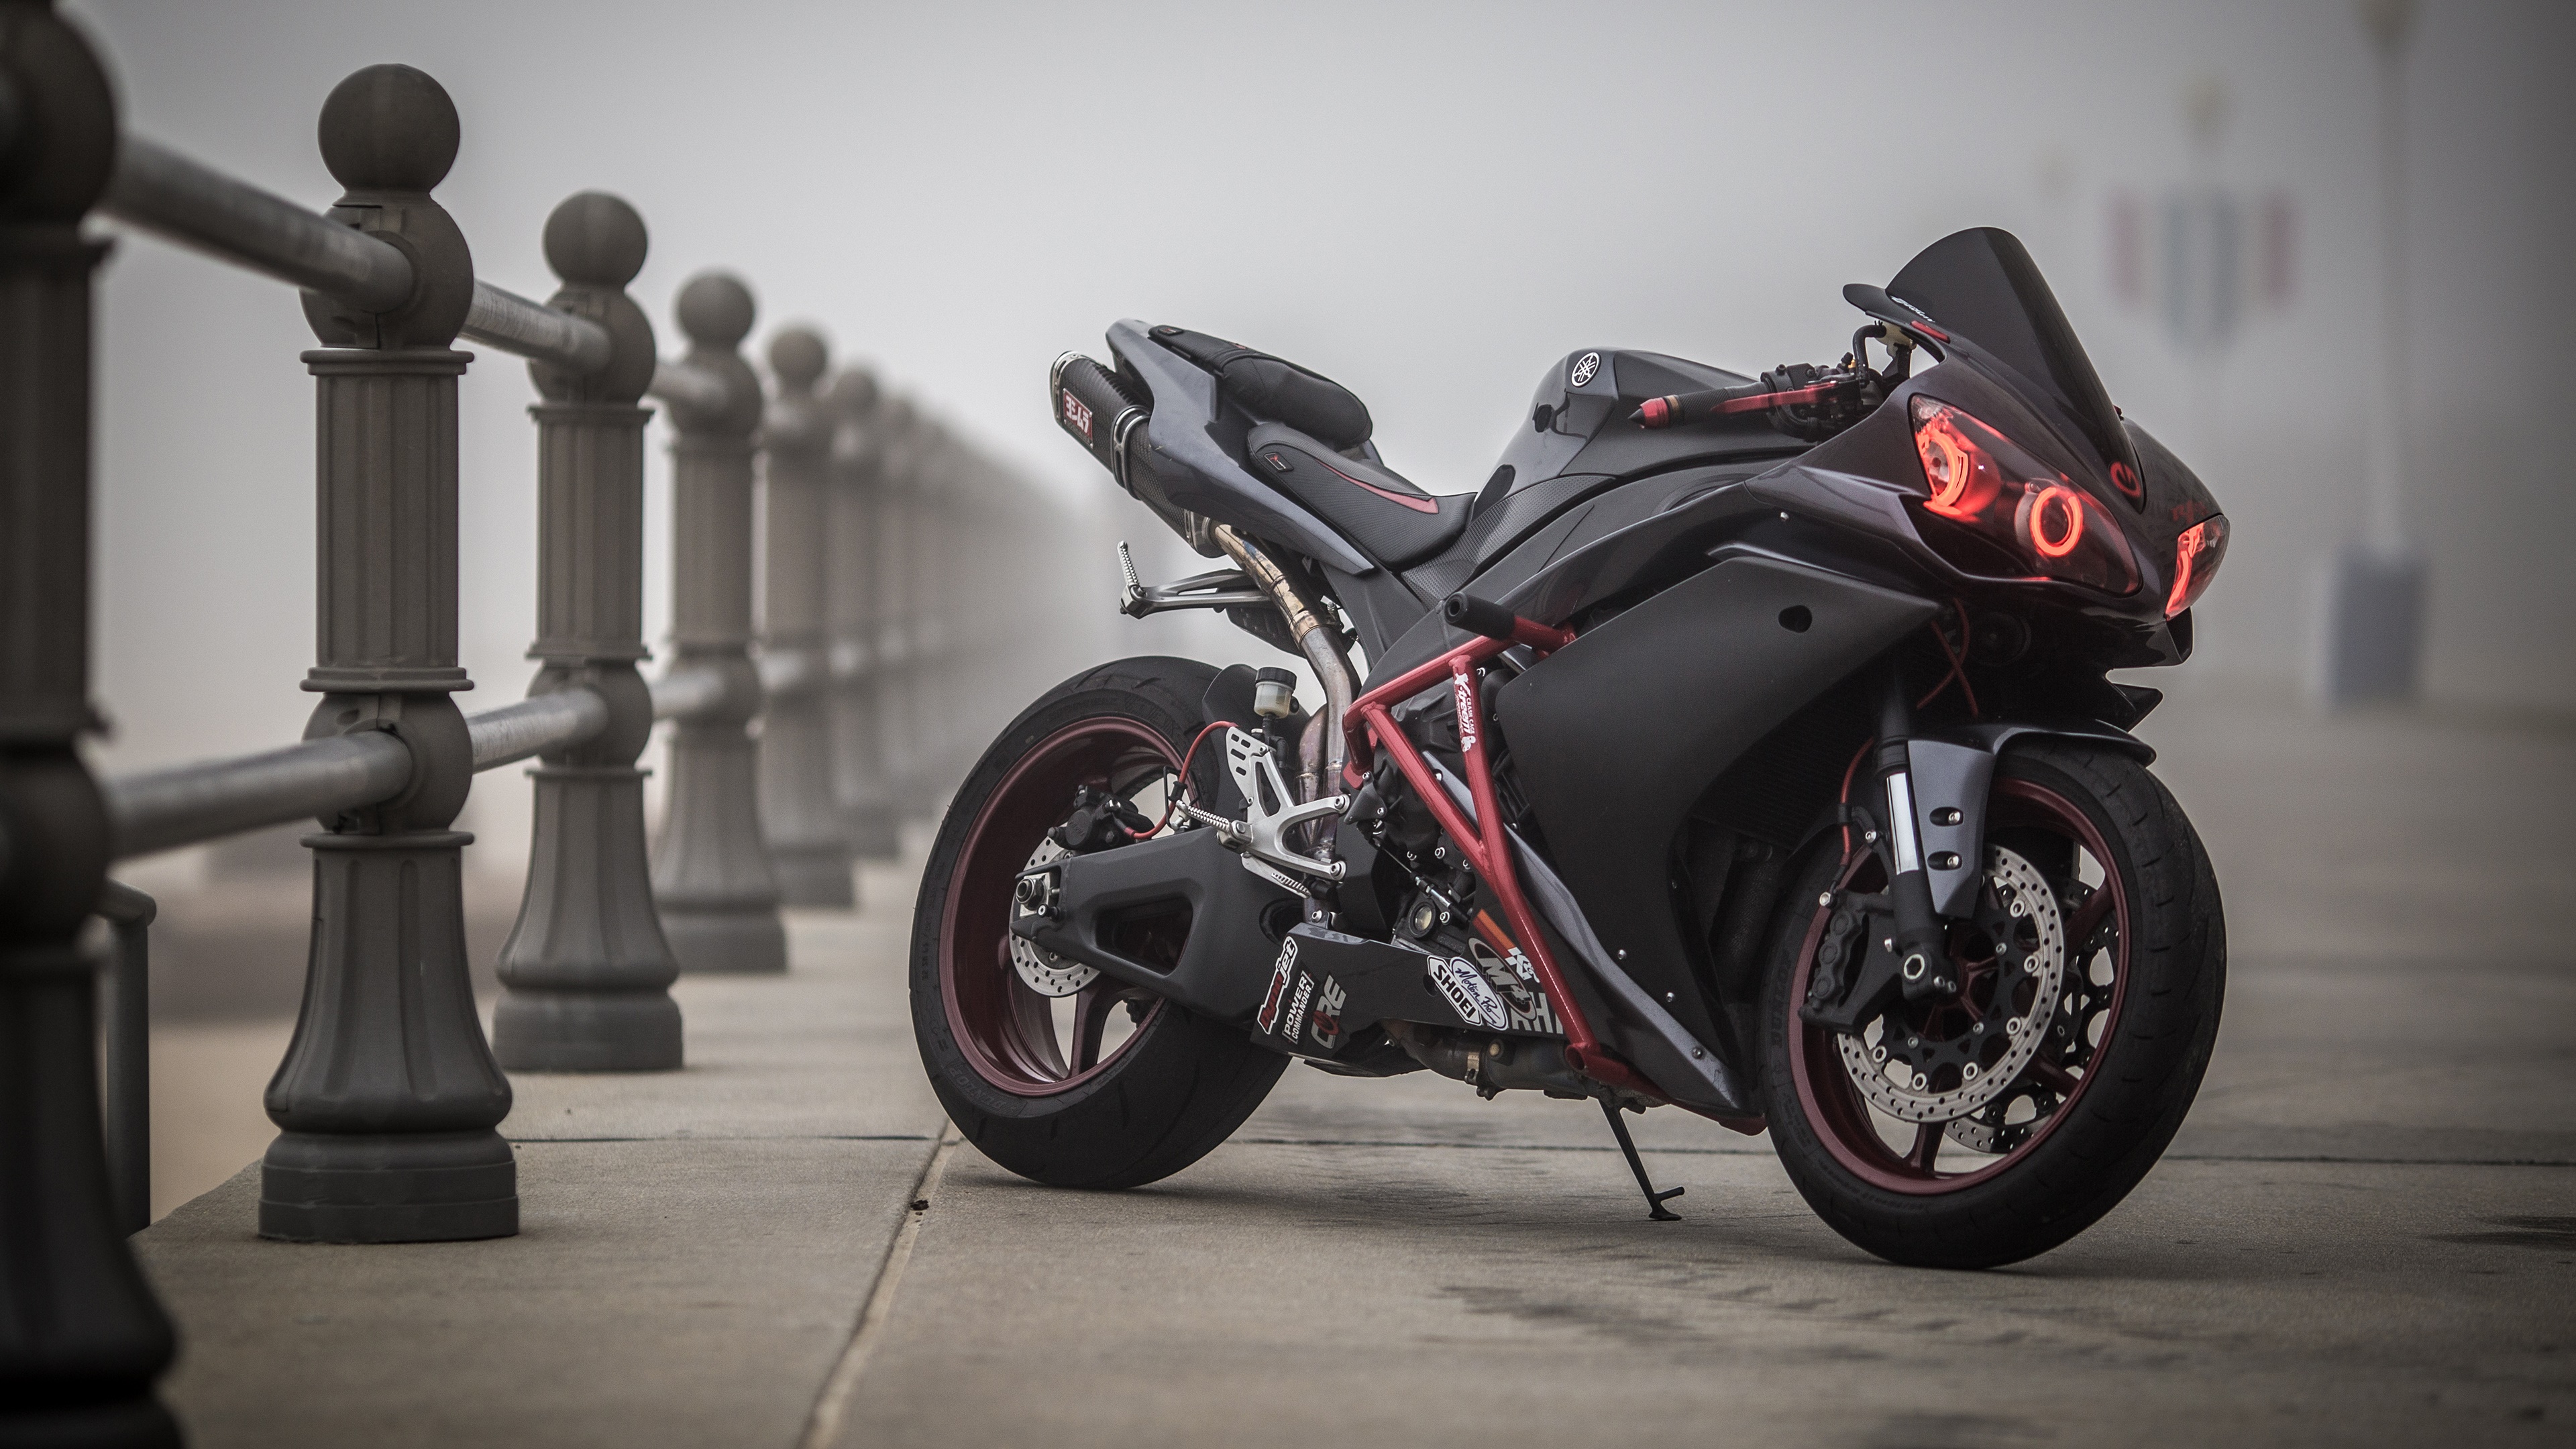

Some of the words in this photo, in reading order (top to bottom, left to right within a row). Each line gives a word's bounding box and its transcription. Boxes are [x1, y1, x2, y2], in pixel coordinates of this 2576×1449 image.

[1284, 976, 1307, 1035] POWER
[1291, 984, 1312, 1039] COMMANDER
[1433, 965, 1477, 1018] SHOEI
[1455, 968, 1480, 1002] Motion
[1481, 996, 1500, 1019] Pro
